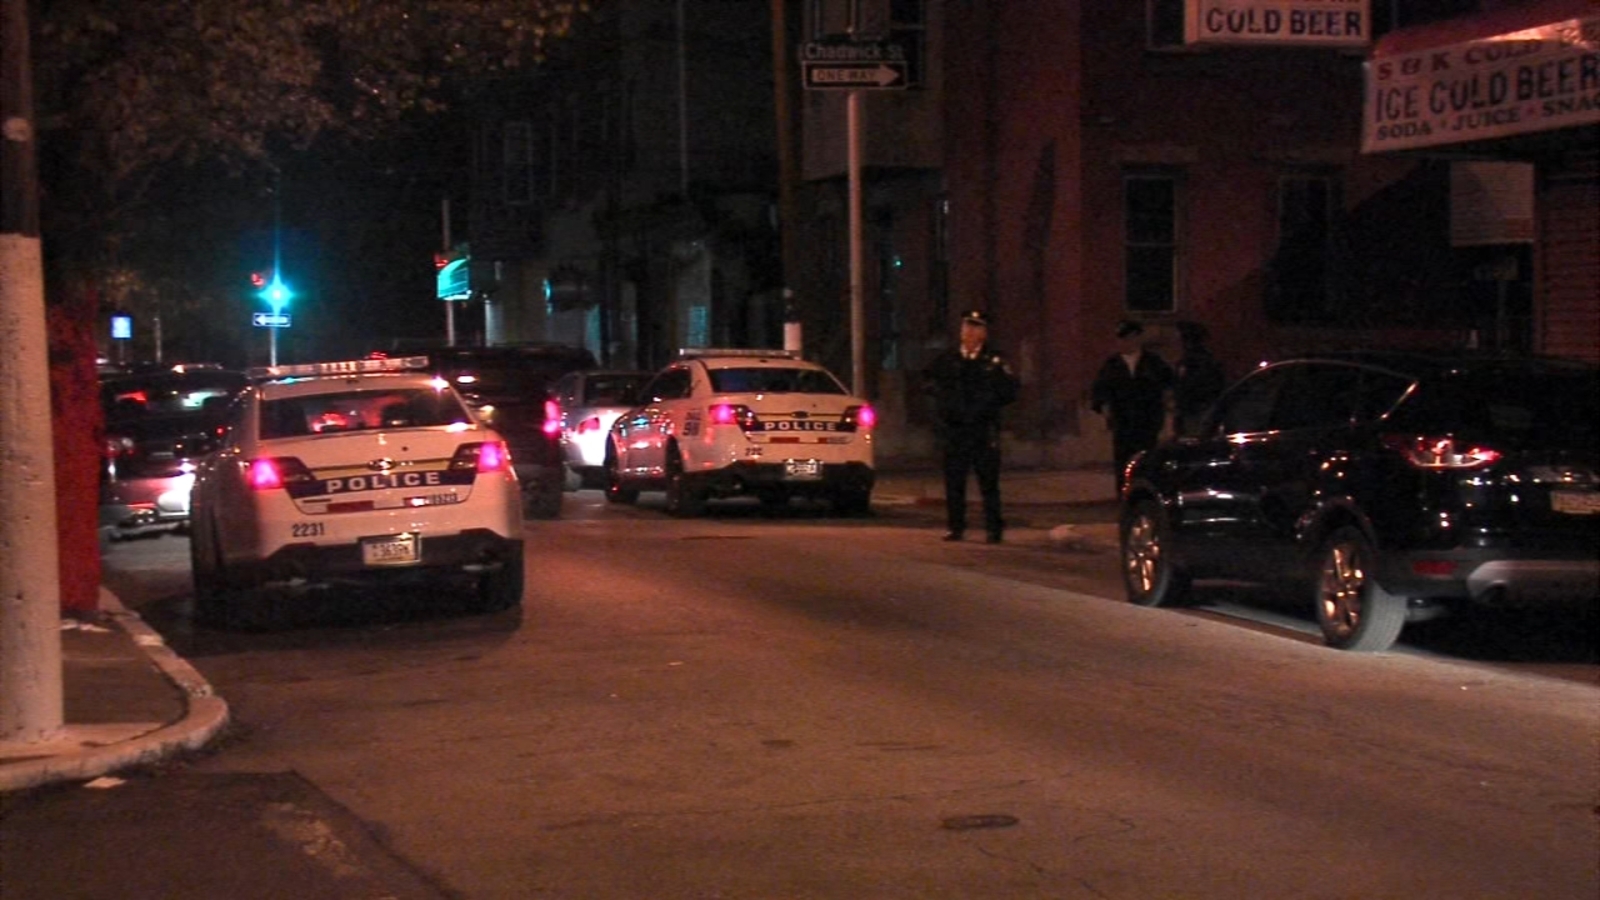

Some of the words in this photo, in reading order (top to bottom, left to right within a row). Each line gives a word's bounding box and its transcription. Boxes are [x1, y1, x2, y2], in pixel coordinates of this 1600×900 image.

[1206, 8, 1281, 34] COLD
[1290, 9, 1361, 36] BEER
[1377, 62, 1393, 80] S
[1401, 58, 1422, 76] &
[1431, 53, 1452, 71] K
[1464, 40, 1542, 65] COLD
[816, 69, 845, 81] ONE
[849, 69, 876, 81] WAY
[1375, 85, 1419, 122] ICE
[1429, 71, 1508, 115] COLD
[1516, 53, 1600, 101] BEER
[1376, 122, 1433, 141] SODA
[1453, 107, 1520, 131] JUICE
[764, 421, 837, 431] POLICE
[326, 471, 441, 493] POLICE
[292, 521, 325, 537] 2231
